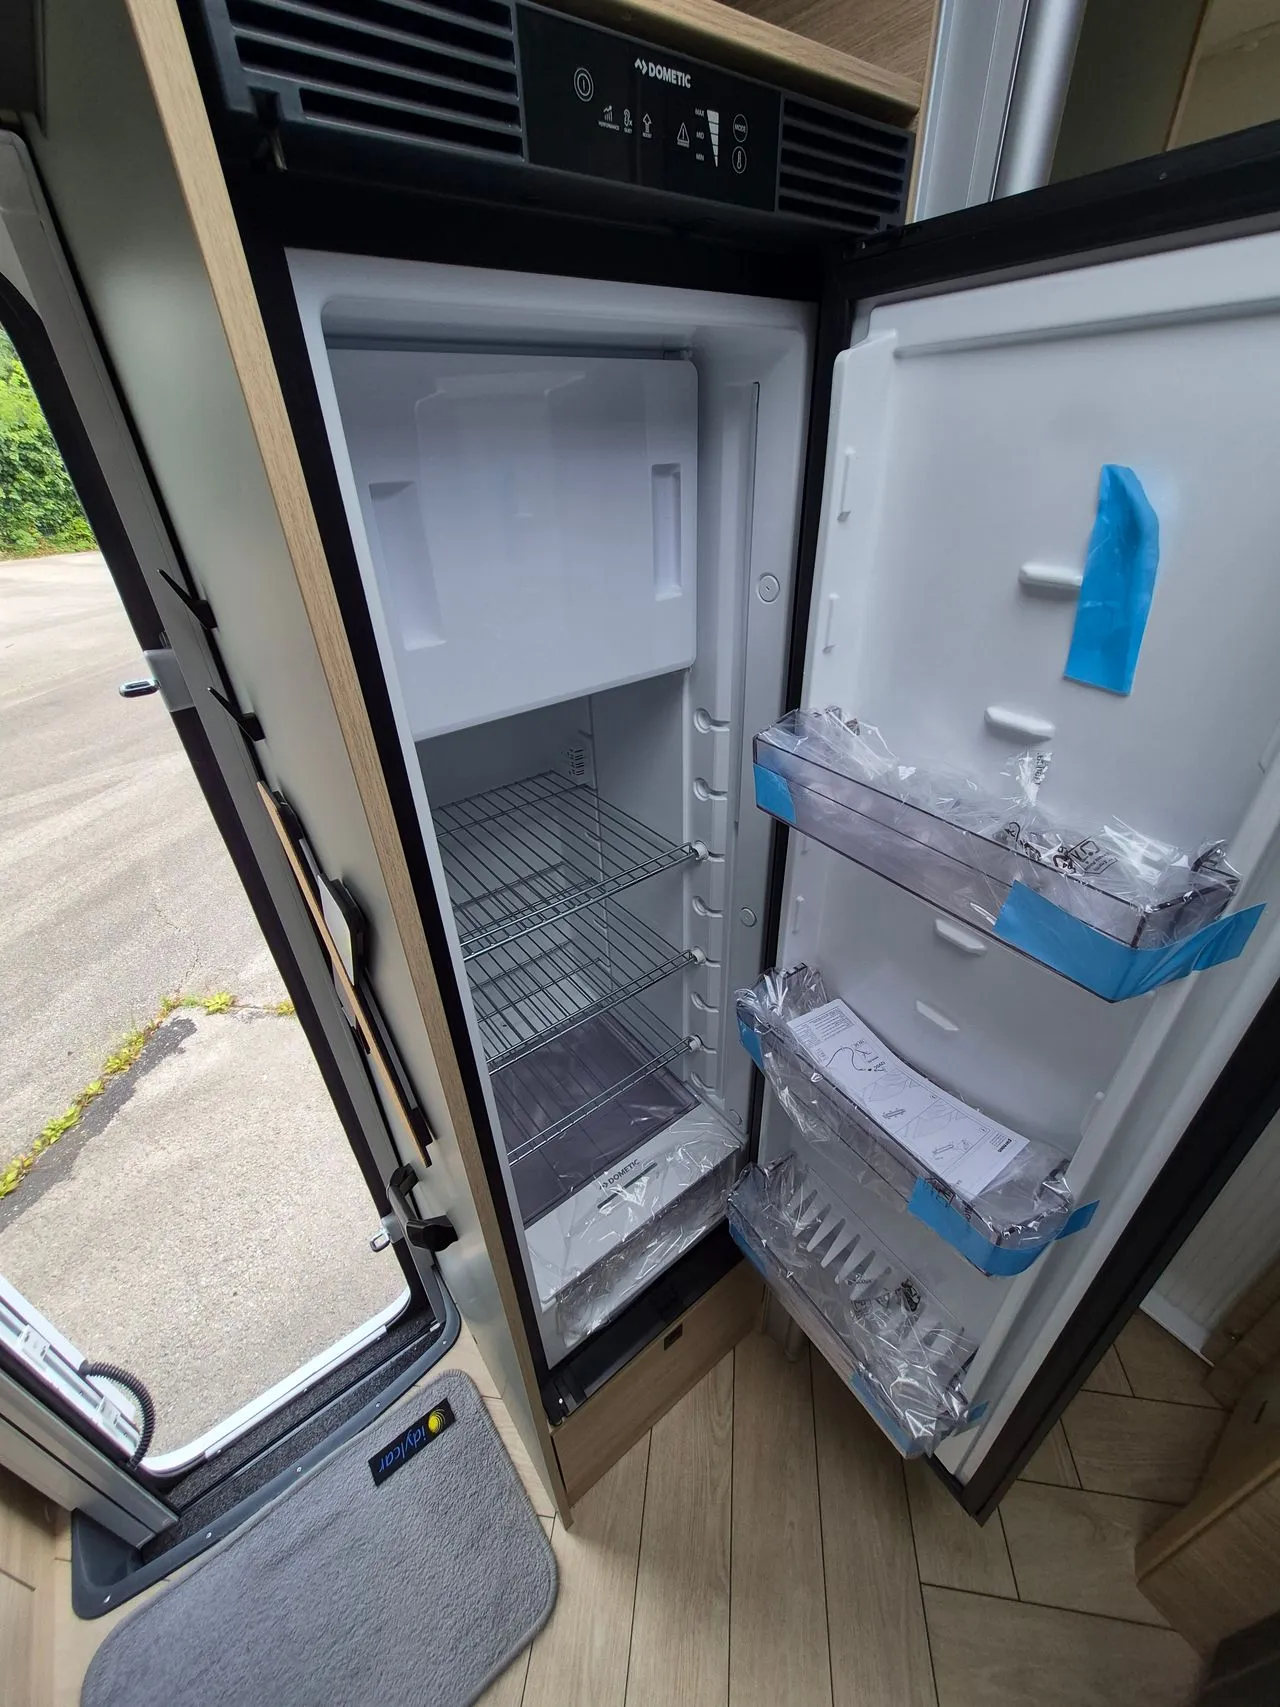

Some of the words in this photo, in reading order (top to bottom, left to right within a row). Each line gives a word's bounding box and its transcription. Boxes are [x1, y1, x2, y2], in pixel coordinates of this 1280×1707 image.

[648, 61, 692, 89] DOMETIC
[694, 108, 705, 117] MAX
[734, 123, 746, 133] MODE
[695, 152, 705, 161] MIN
[608, 1158, 640, 1185] DOMETIC
[378, 1425, 427, 1473] idylcar
